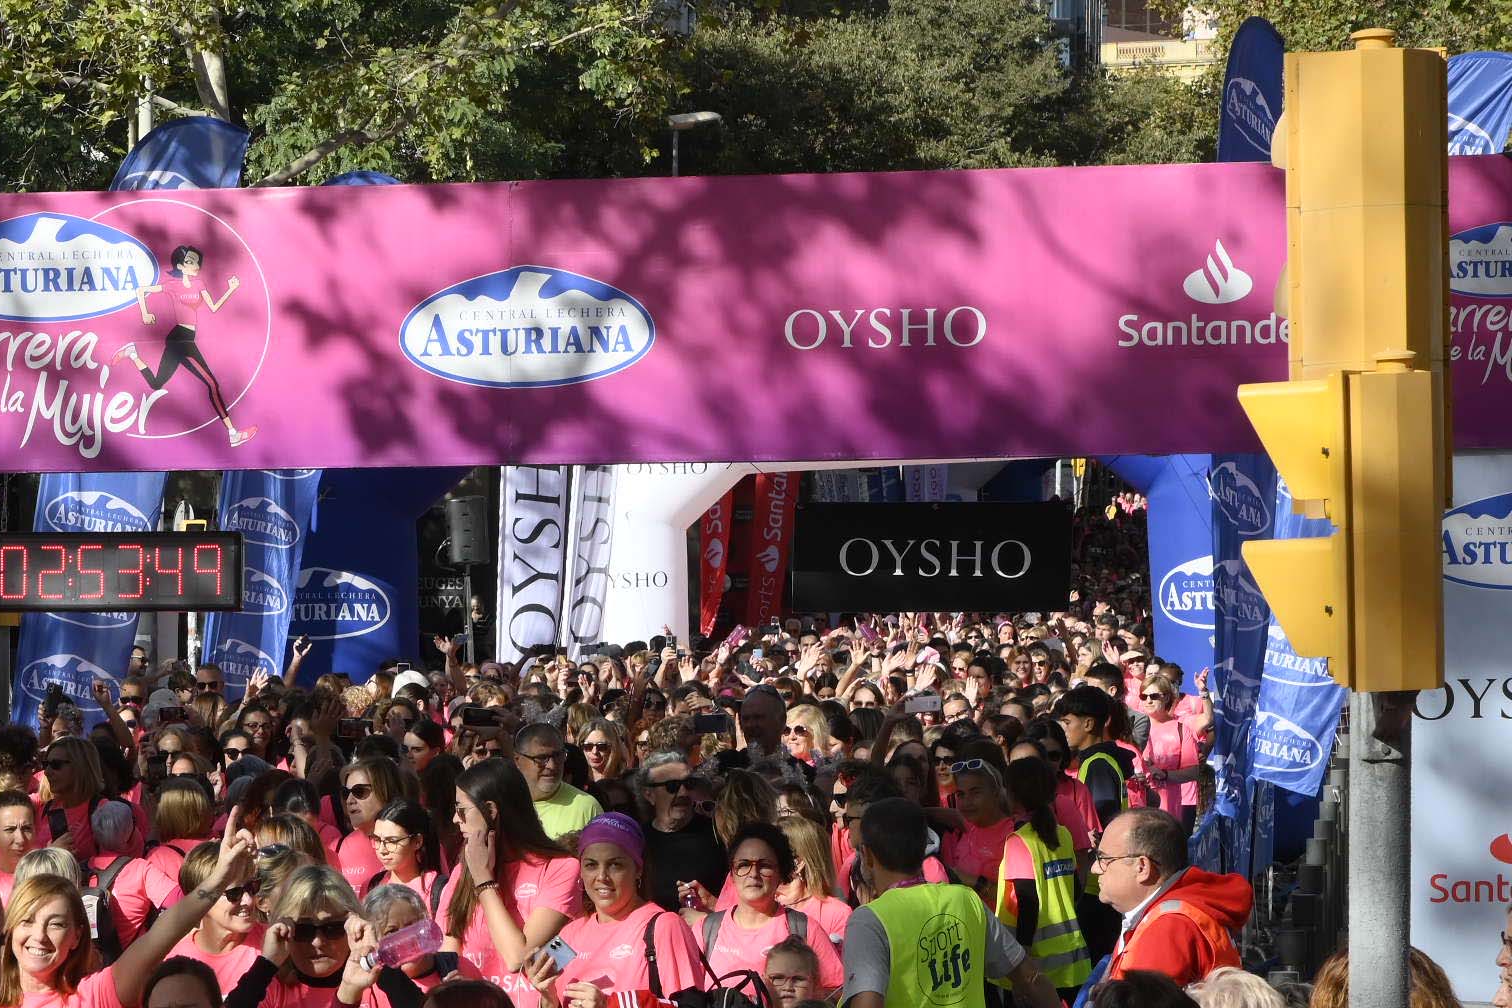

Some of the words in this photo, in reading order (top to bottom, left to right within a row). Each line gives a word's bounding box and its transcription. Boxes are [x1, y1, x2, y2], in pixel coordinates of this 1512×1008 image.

[1228, 87, 1271, 144] ASTURIAN
[459, 308, 537, 321] CENTRAL
[546, 305, 626, 319] LECHERA
[783, 305, 988, 351] OYSHO
[1117, 313, 1290, 348] Santande
[419, 313, 635, 357] ASTURIANA
[1468, 333, 1486, 361] la
[0, 374, 25, 414] la
[20, 365, 169, 460] Mujer
[763, 472, 788, 542] Santa
[0, 544, 221, 599] 02:53:49
[509, 465, 561, 657] OYSH
[569, 465, 613, 643] OYSH
[839, 537, 1032, 578] OYSHO
[242, 590, 282, 610] RIANA
[609, 570, 669, 588] YSHO
[1182, 580, 1215, 588] CENT
[1411, 677, 1512, 721] OYS
[1255, 737, 1312, 765] URIANA
[1430, 873, 1512, 903] Sant
[919, 921, 963, 963] Sport
[928, 943, 971, 991] Life
